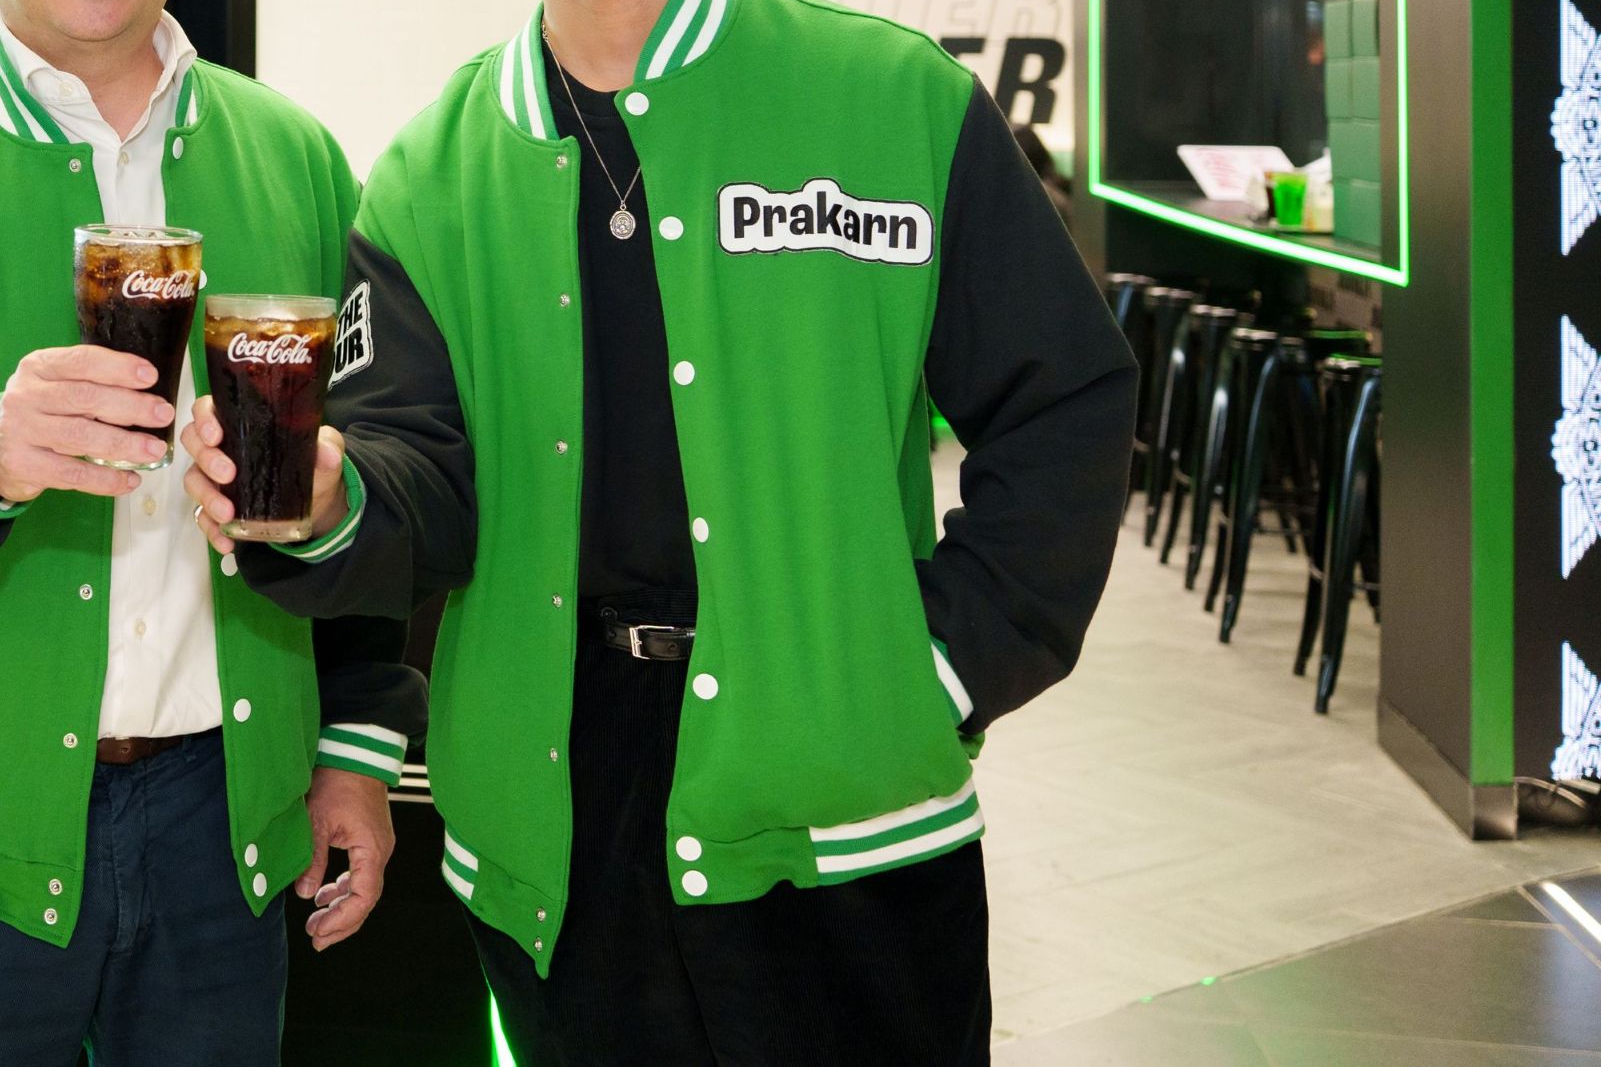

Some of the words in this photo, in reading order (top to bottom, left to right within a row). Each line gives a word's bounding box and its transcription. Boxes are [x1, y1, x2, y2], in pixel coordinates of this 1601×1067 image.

[733, 190, 918, 250] Prakarn
[121, 269, 196, 300] Coca-Cola
[227, 332, 313, 365] Coca-Cola
